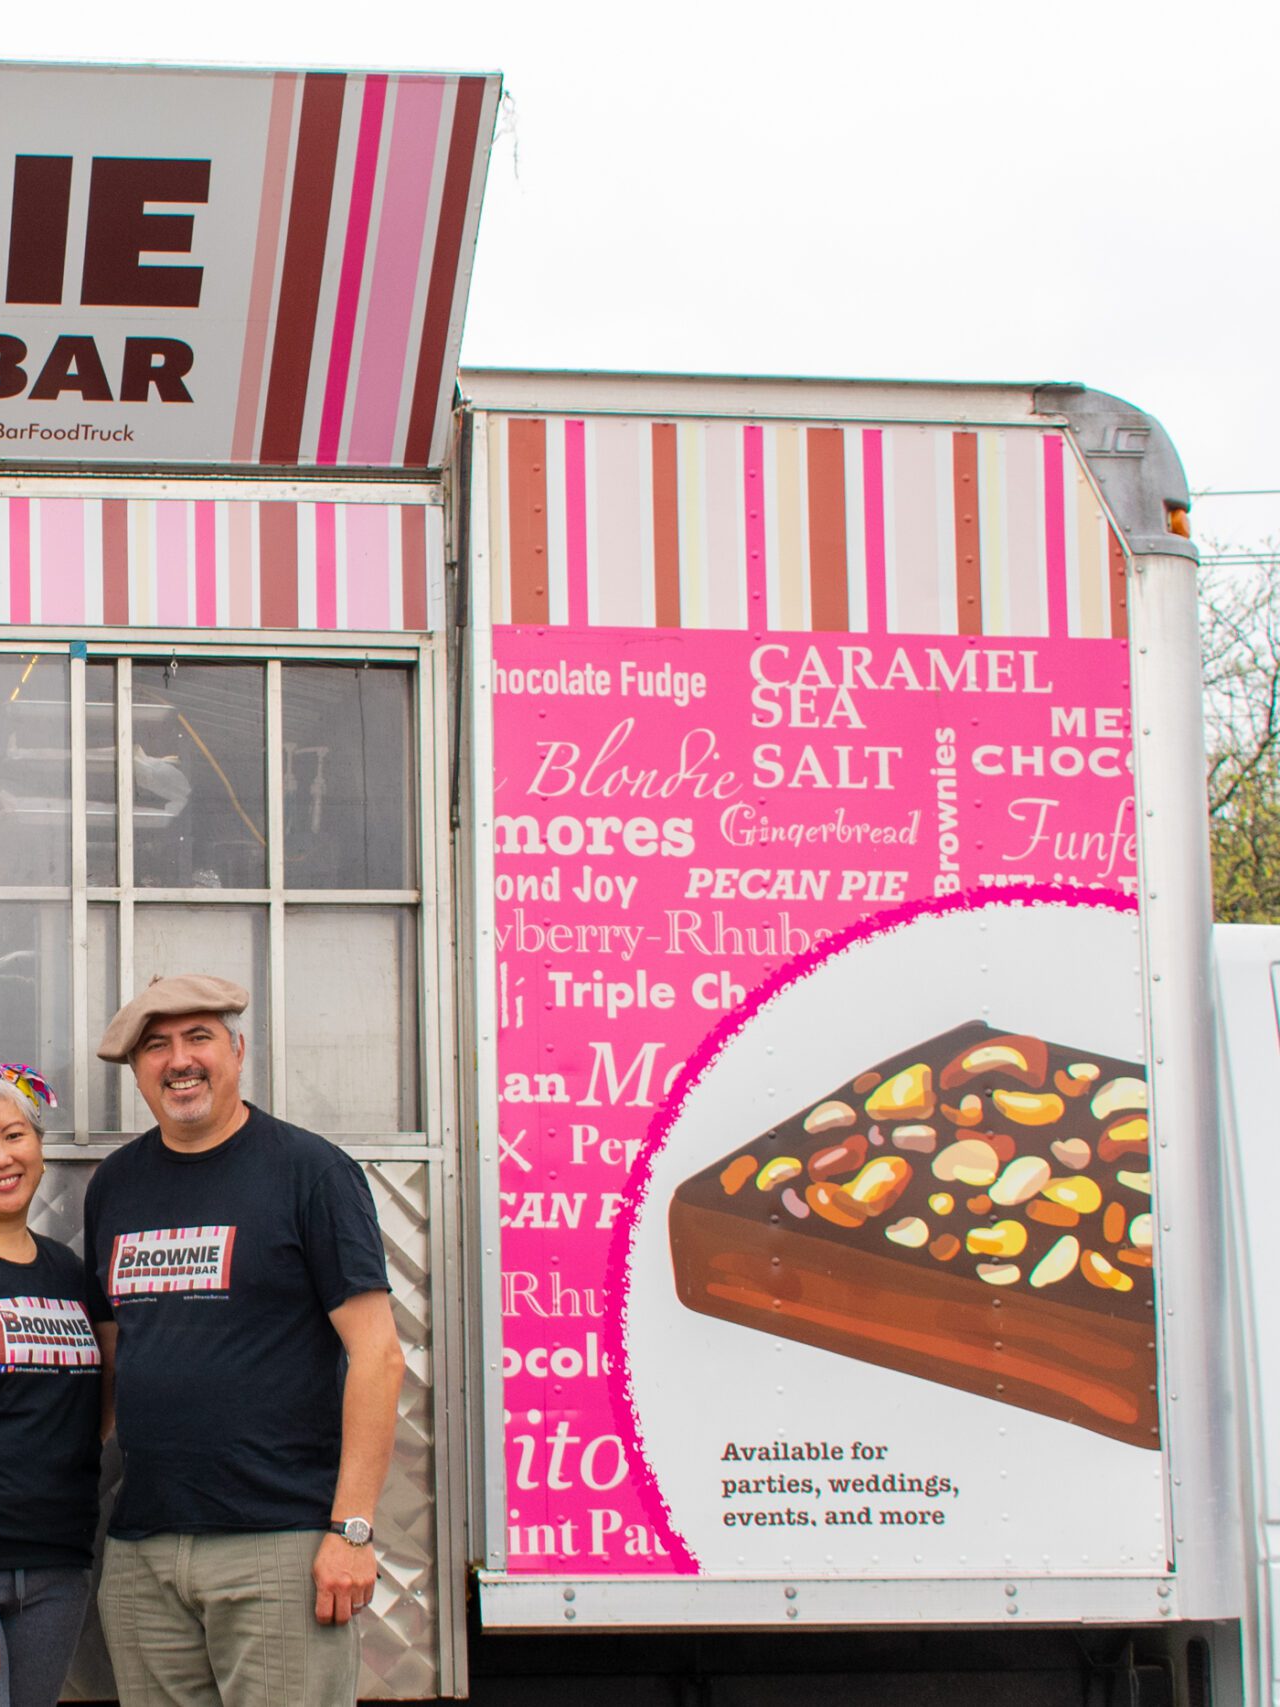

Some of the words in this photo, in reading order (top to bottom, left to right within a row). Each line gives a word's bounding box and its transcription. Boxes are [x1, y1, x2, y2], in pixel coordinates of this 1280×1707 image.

[620, 661, 707, 707] Fudge
[749, 643, 1053, 693] CARAMEL
[751, 683, 867, 729] SEA
[1050, 707, 1133, 738] ME
[526, 717, 743, 800] Blondie
[752, 744, 903, 790] SALT
[720, 800, 922, 848] Gingerbread
[930, 727, 961, 898] Brownies
[572, 865, 638, 909] Joy
[684, 867, 831, 901] PECAN
[838, 870, 909, 902] PIE
[548, 969, 676, 1019] Triple
[498, 1071, 570, 1104] an
[119, 1245, 220, 1268] BROWNIE
[194, 1265, 218, 1274] BAR
[1, 1311, 92, 1336] BROWNIE
[76, 1337, 97, 1347] BAR
[503, 1332, 611, 1378] ocol
[504, 1408, 630, 1491] ito
[720, 1441, 844, 1462] Available
[850, 1441, 888, 1461] for
[721, 1474, 821, 1499] parties,
[827, 1472, 960, 1498] weddings,
[825, 1507, 872, 1525] and
[879, 1510, 946, 1525] more
